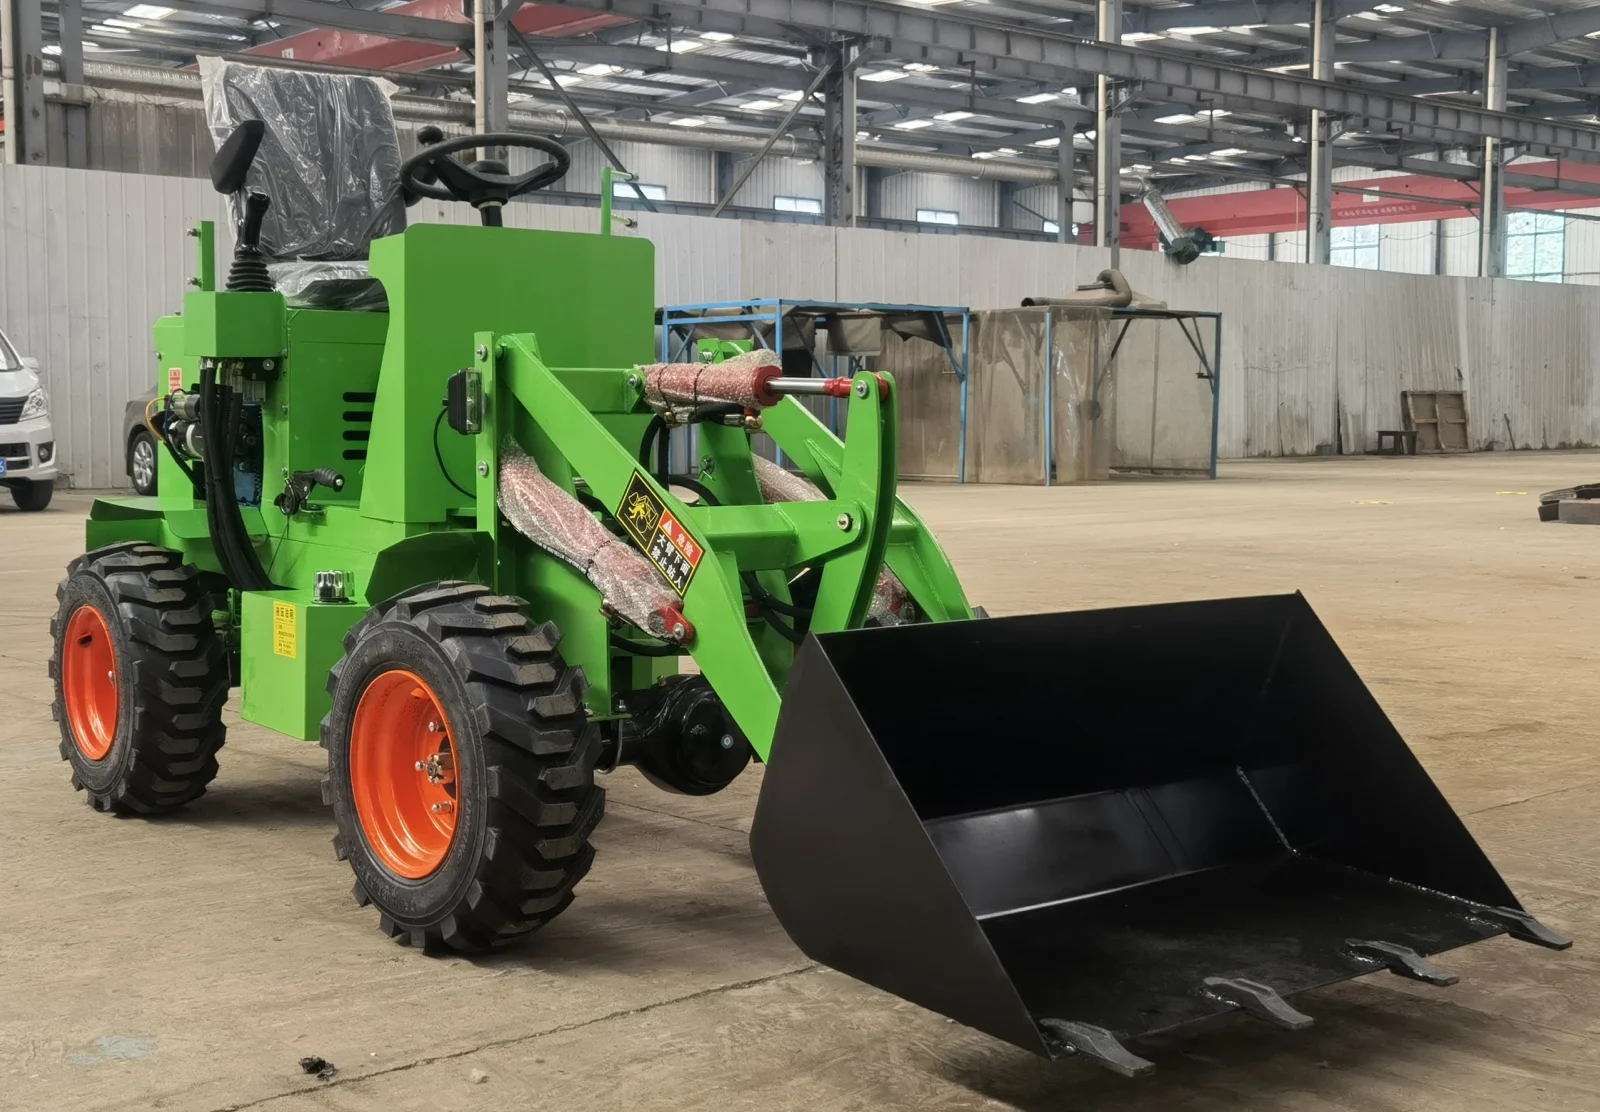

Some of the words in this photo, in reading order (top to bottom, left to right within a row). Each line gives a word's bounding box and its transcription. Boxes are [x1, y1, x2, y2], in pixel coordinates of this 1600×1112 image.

[651, 545, 682, 589] 禁止站人
[656, 533, 691, 577] 大臂下面
[676, 533, 694, 558] 危险
